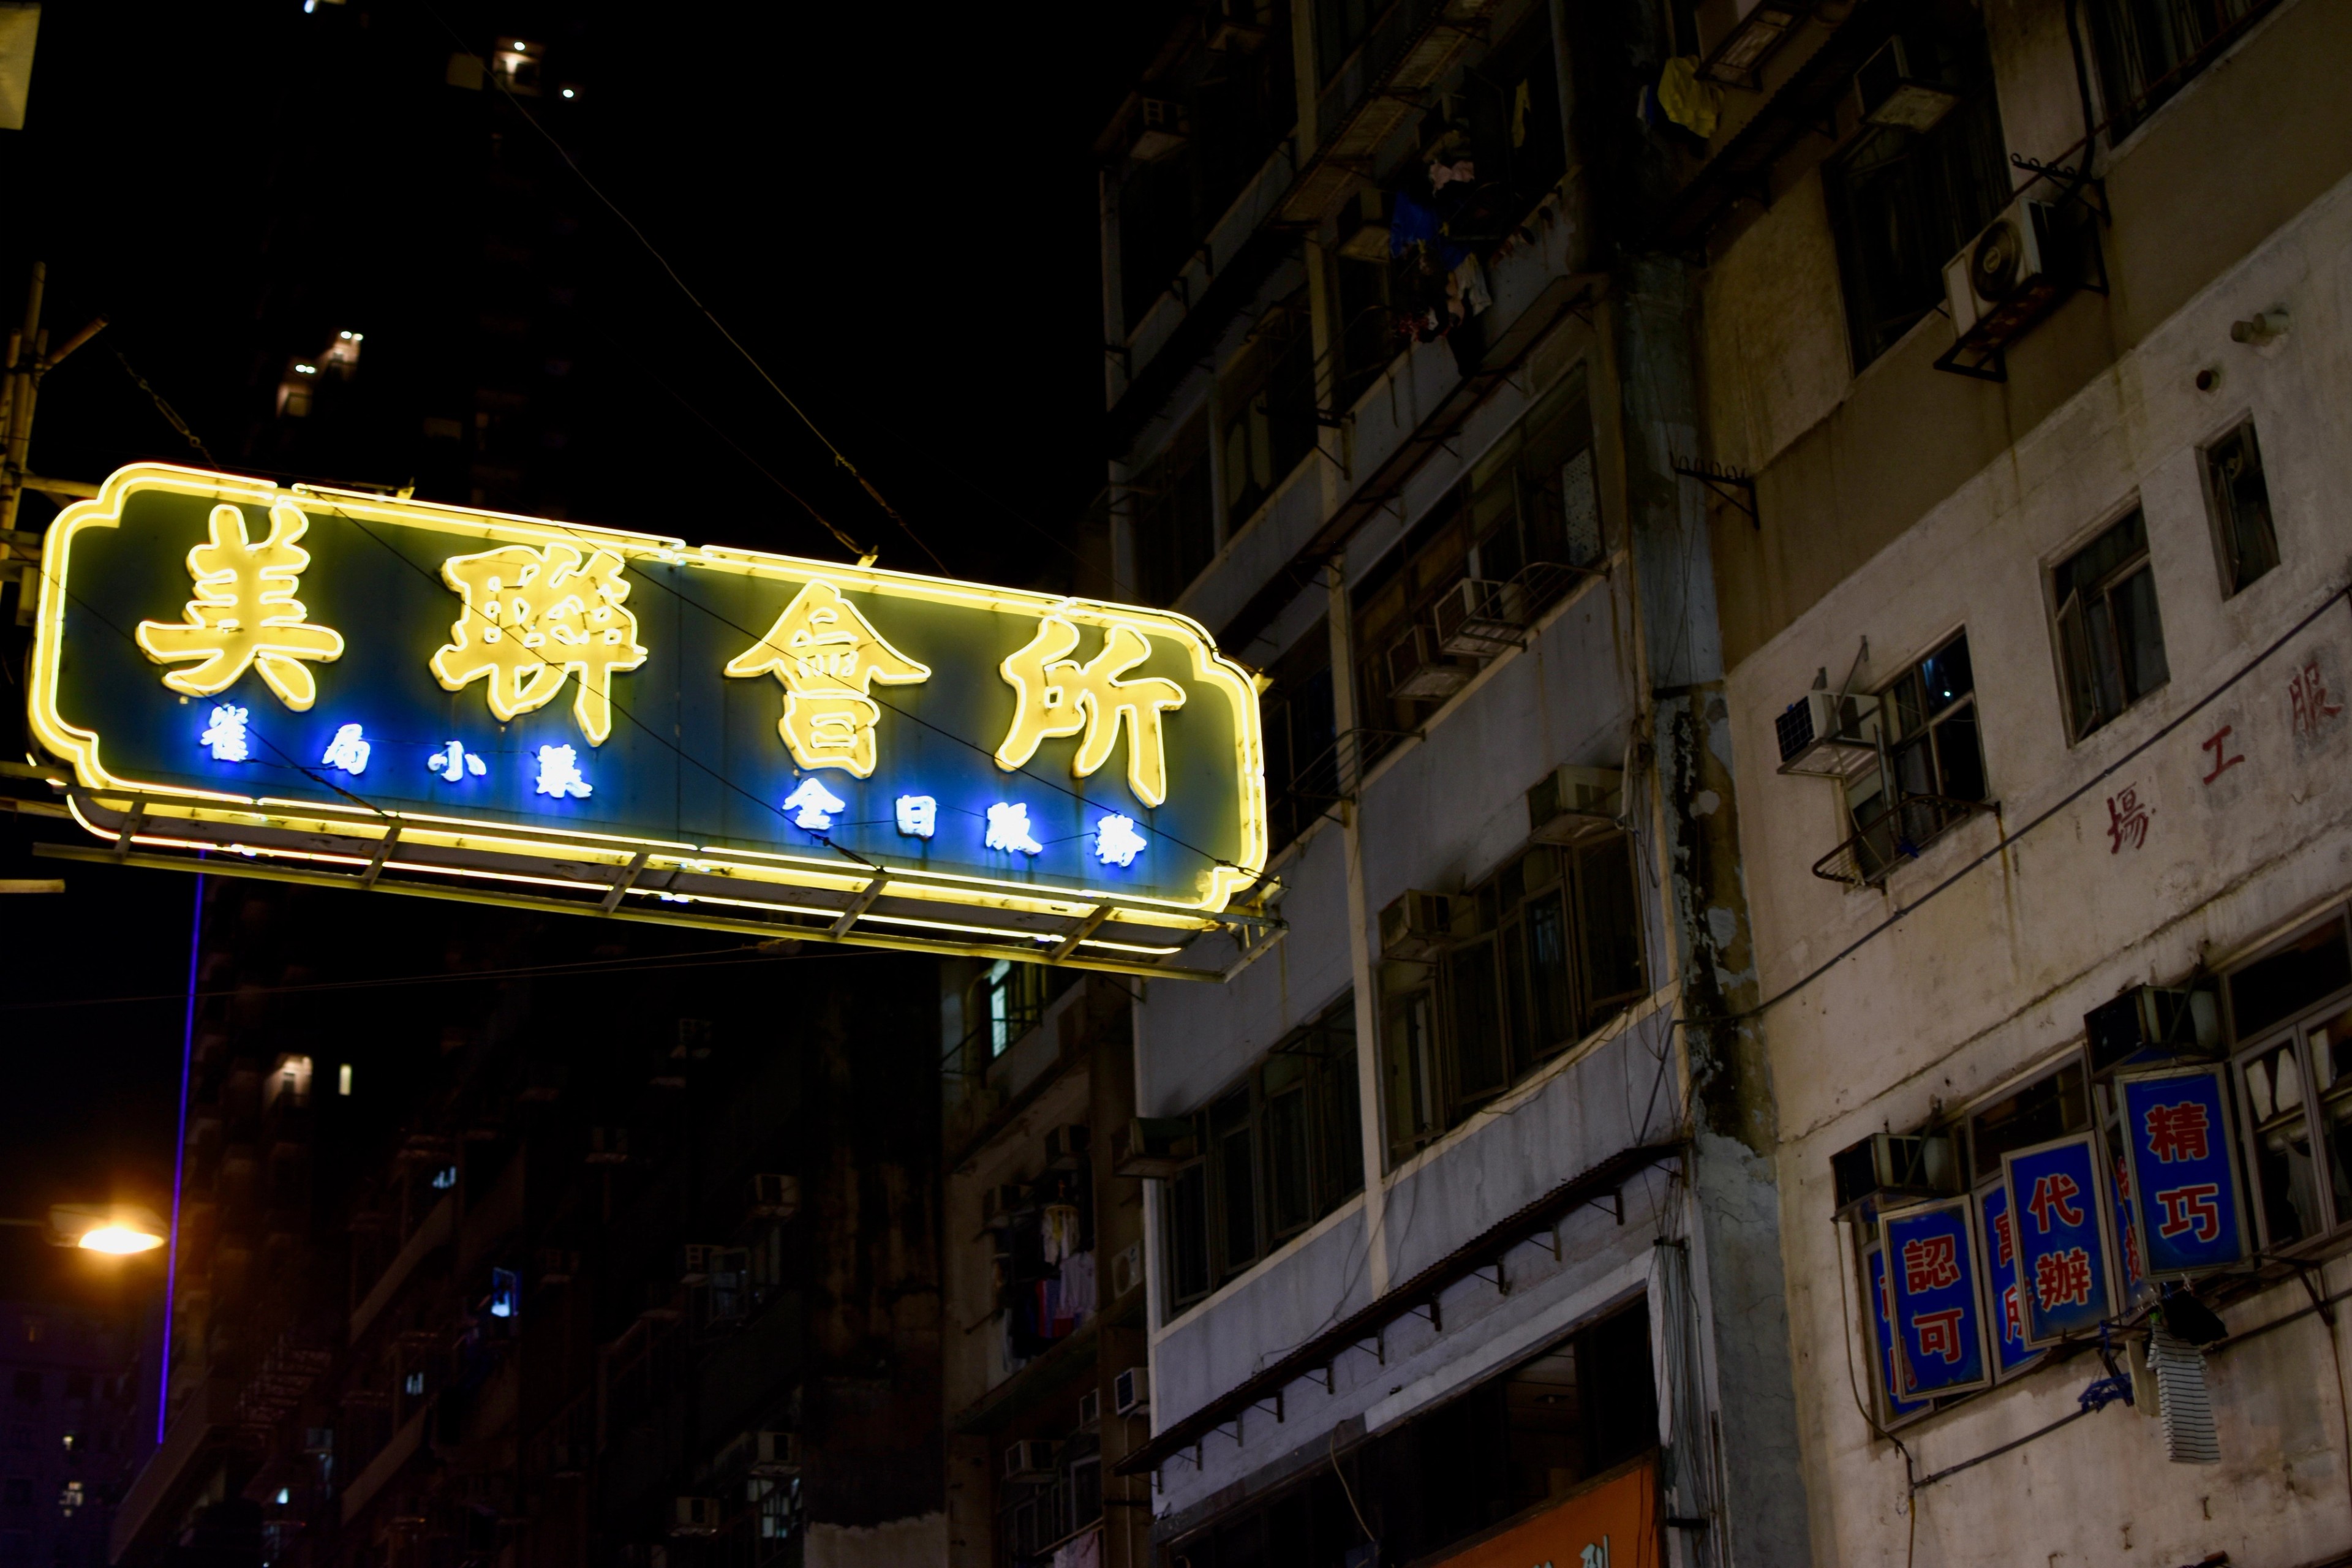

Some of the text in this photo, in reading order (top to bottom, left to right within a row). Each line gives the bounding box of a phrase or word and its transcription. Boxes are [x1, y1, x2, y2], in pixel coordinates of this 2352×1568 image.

[135, 503, 1186, 809] 美聯會所
[2027, 1172, 2092, 1313] 代辦
[2145, 1101, 2220, 1243] 精巧
[1903, 1233, 1965, 1365] 認可
